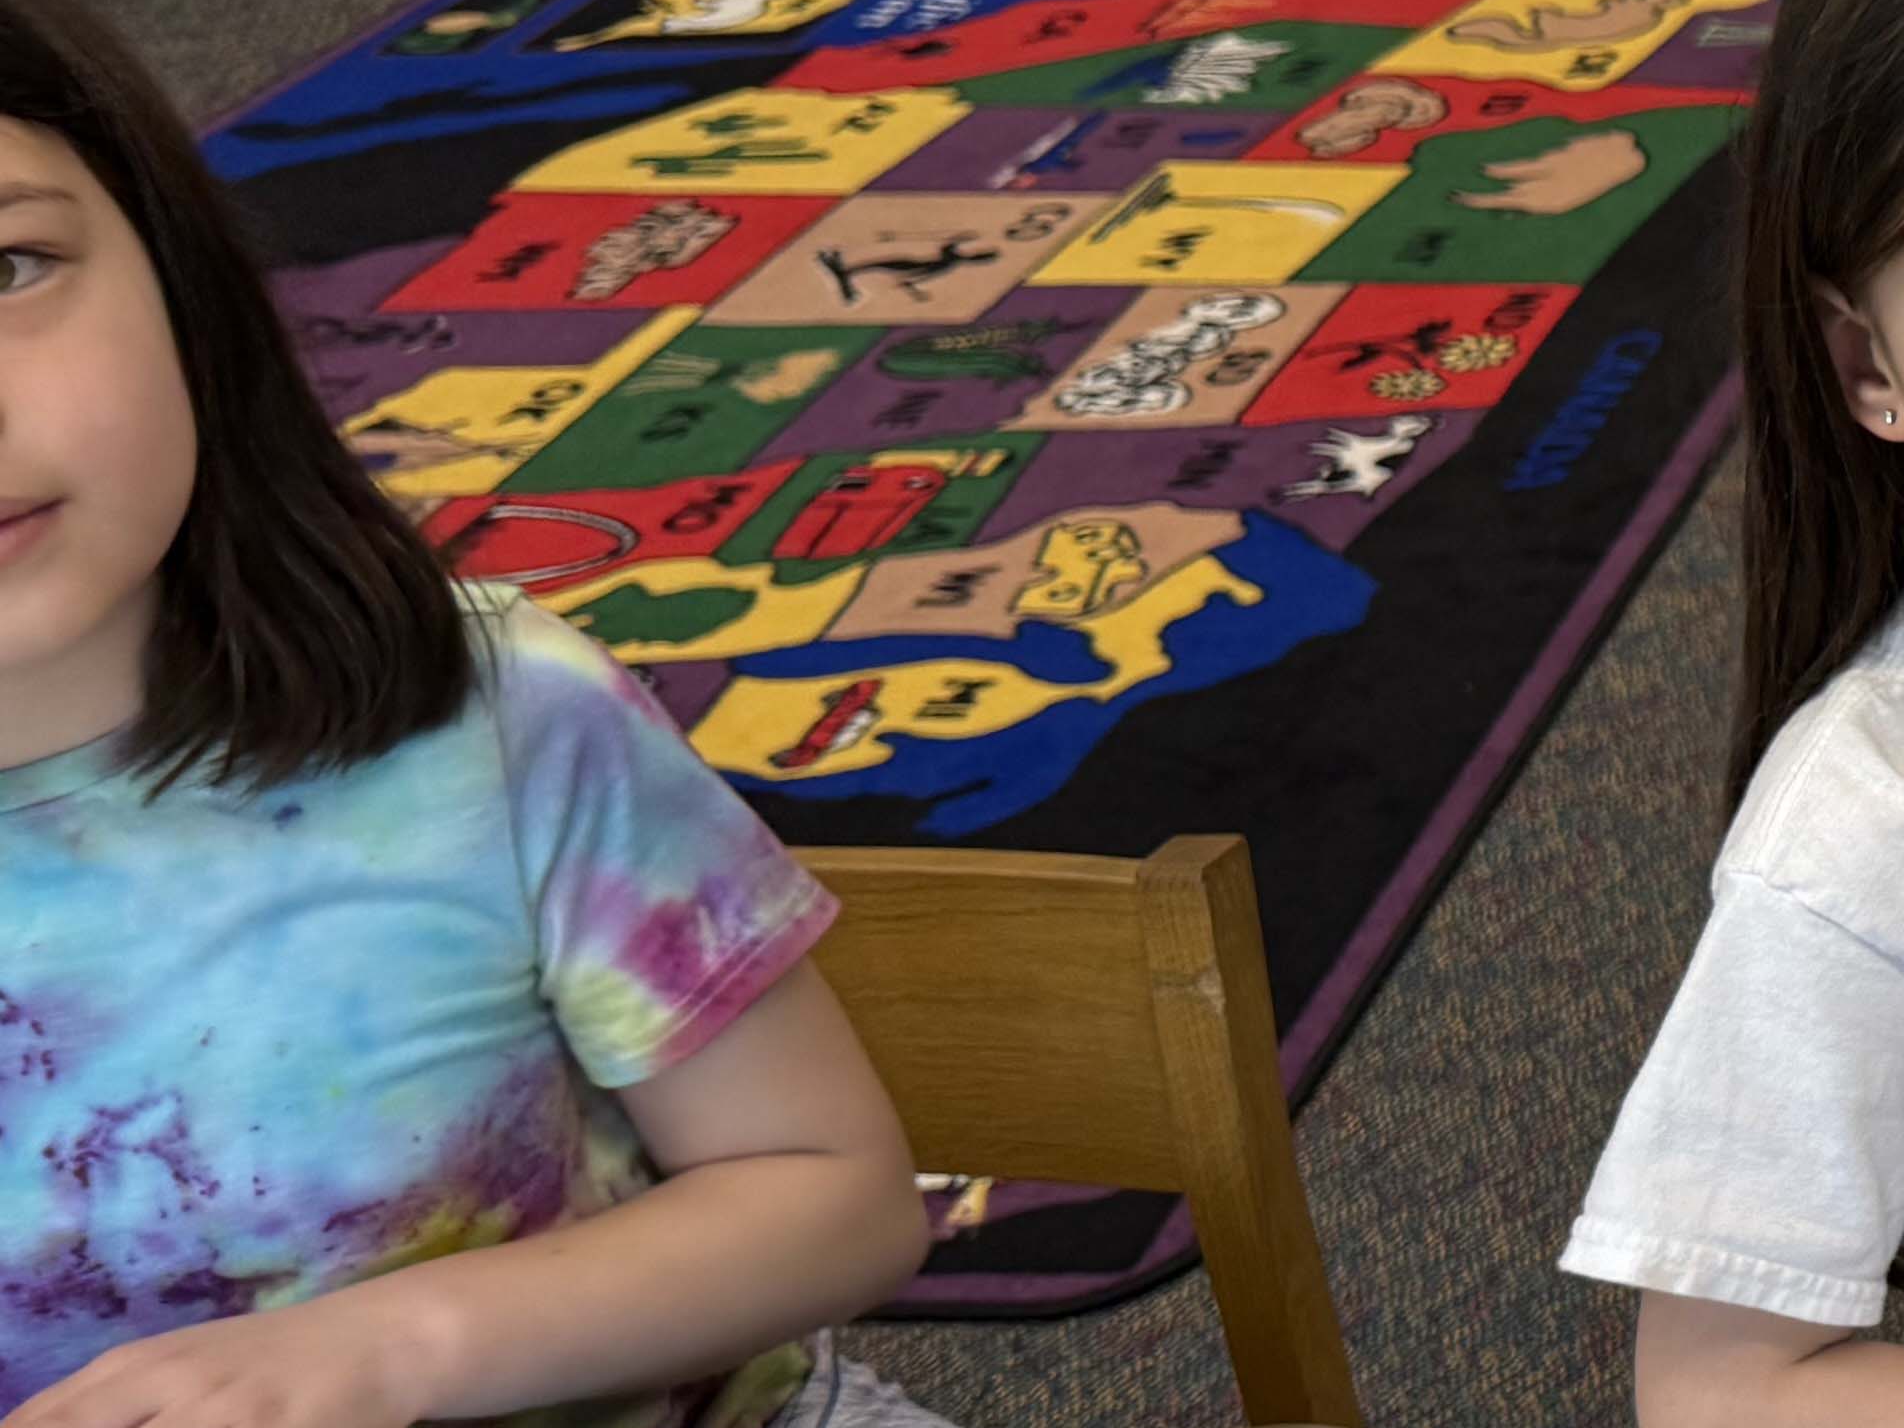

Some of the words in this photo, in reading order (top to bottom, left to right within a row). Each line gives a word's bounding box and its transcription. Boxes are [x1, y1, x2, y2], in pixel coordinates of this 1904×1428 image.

[497, 379, 586, 427] OK
[1504, 328, 1663, 492] CANADA
[662, 483, 753, 534] MO
